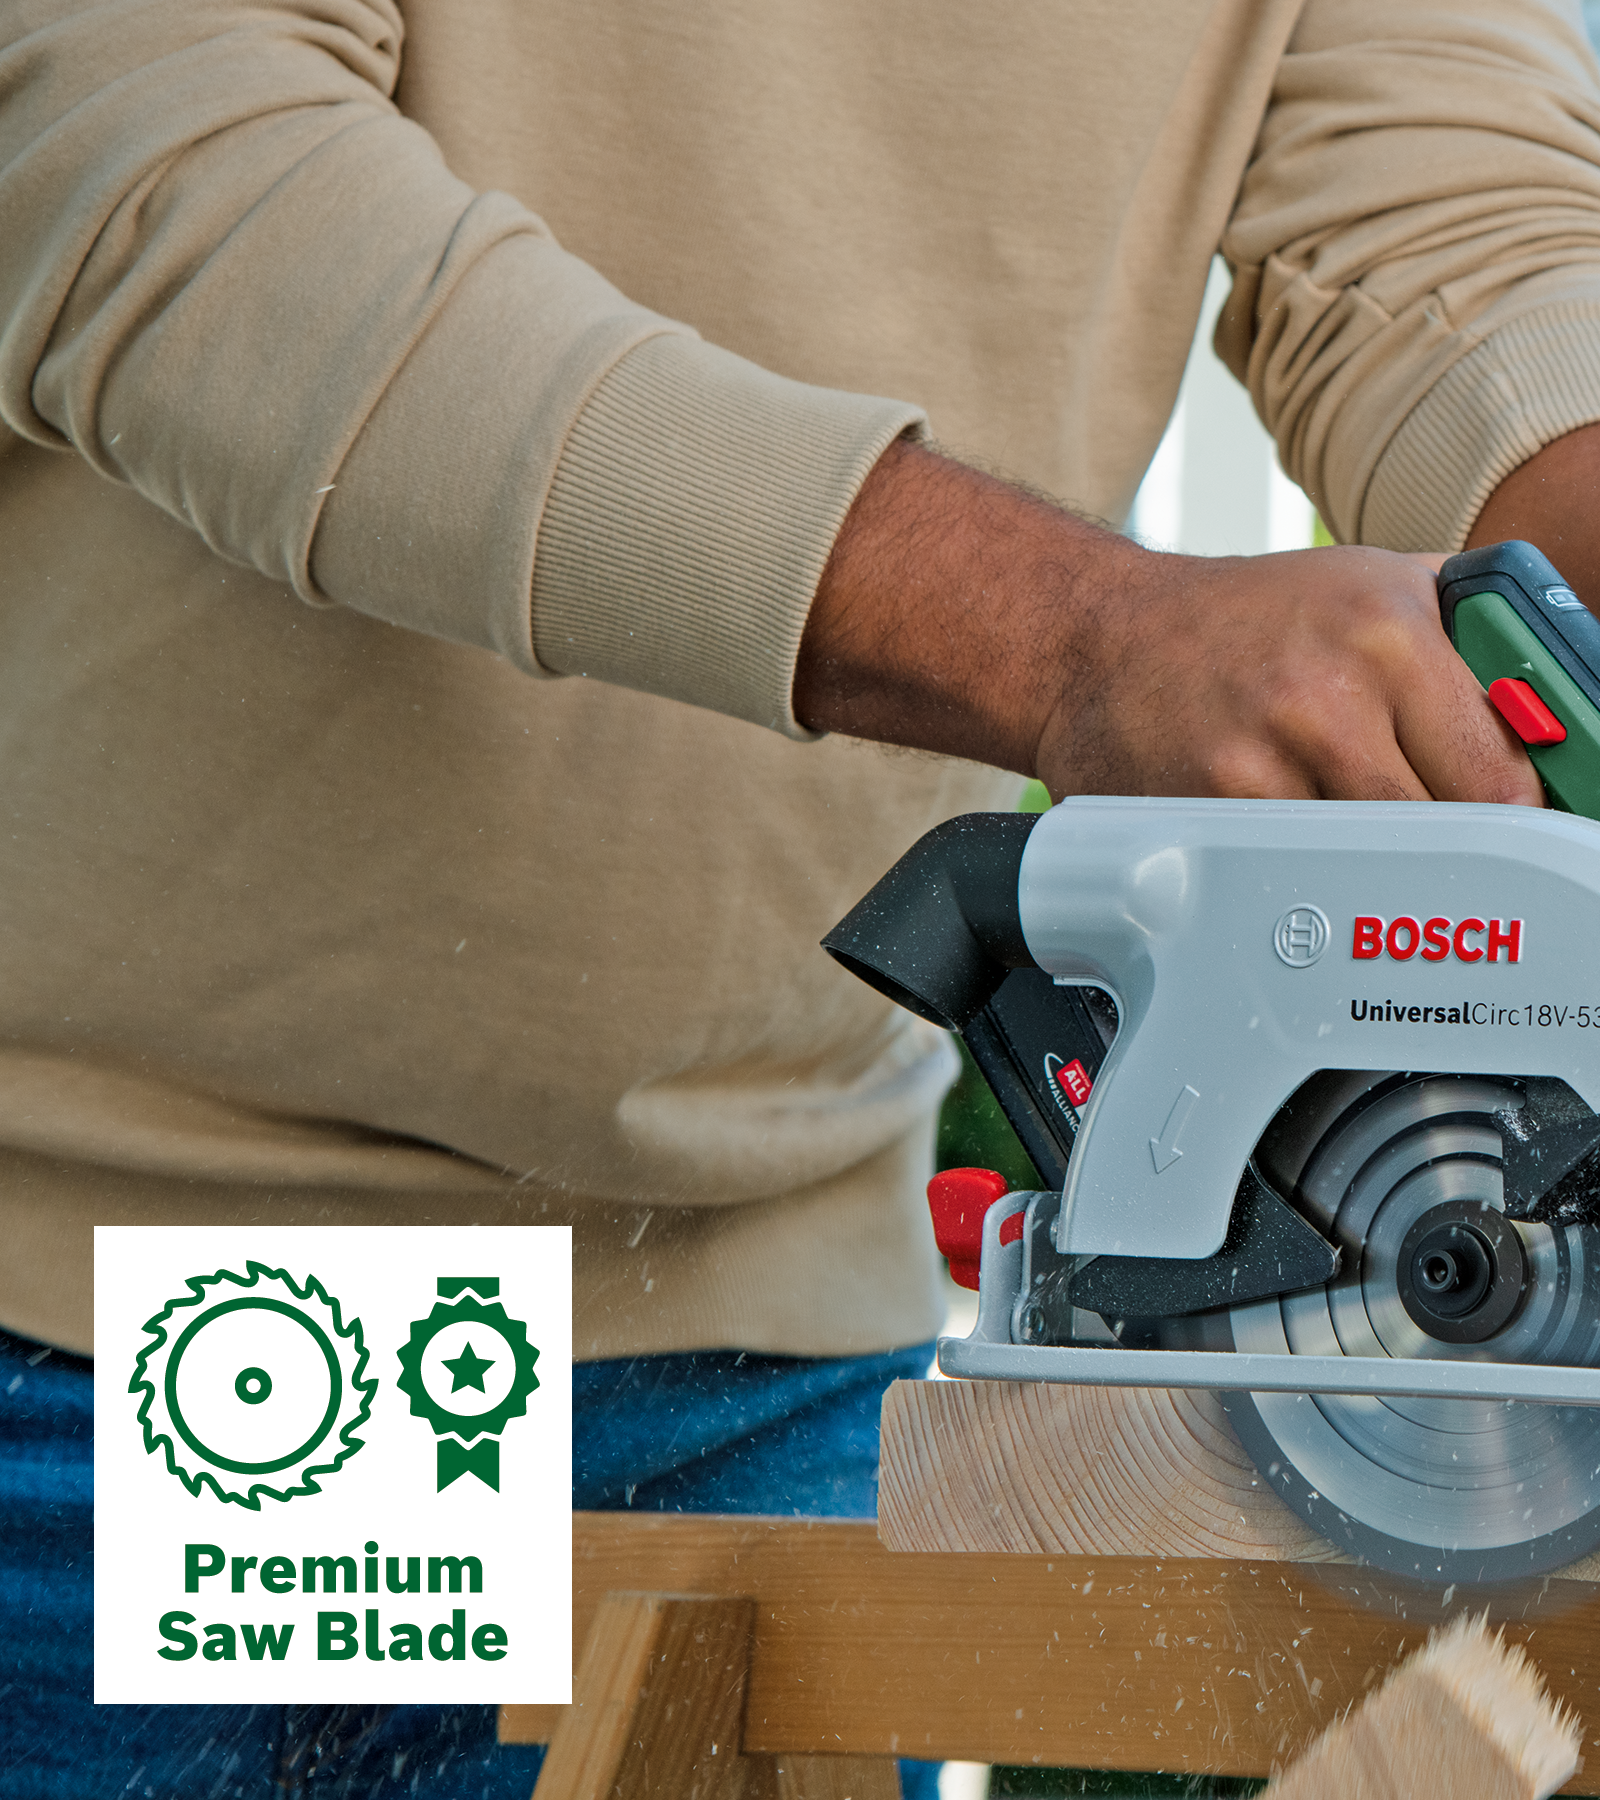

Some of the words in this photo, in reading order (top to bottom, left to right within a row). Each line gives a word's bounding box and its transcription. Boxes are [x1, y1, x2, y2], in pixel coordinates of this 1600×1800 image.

[1353, 916, 1521, 963] BOSCH
[1064, 1070, 1086, 1100] ALL
[1051, 1089, 1080, 1134] ALLIANC
